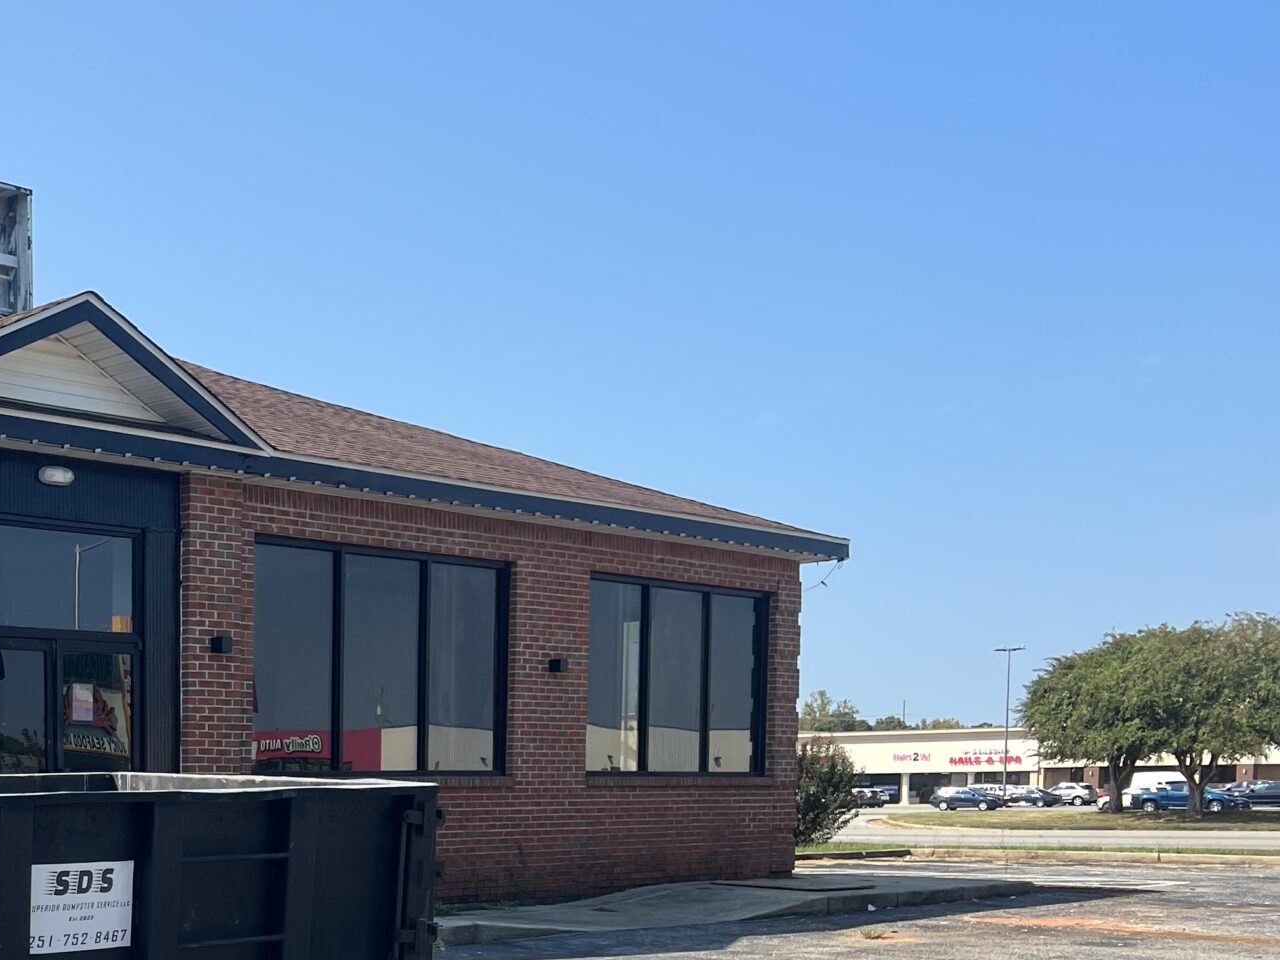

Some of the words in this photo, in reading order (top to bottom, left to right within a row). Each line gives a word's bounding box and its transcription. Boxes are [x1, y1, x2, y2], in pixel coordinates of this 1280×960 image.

[913, 752, 919, 762] 2
[53, 868, 115, 896] SDS
[62, 902, 95, 911] DUMPSTER
